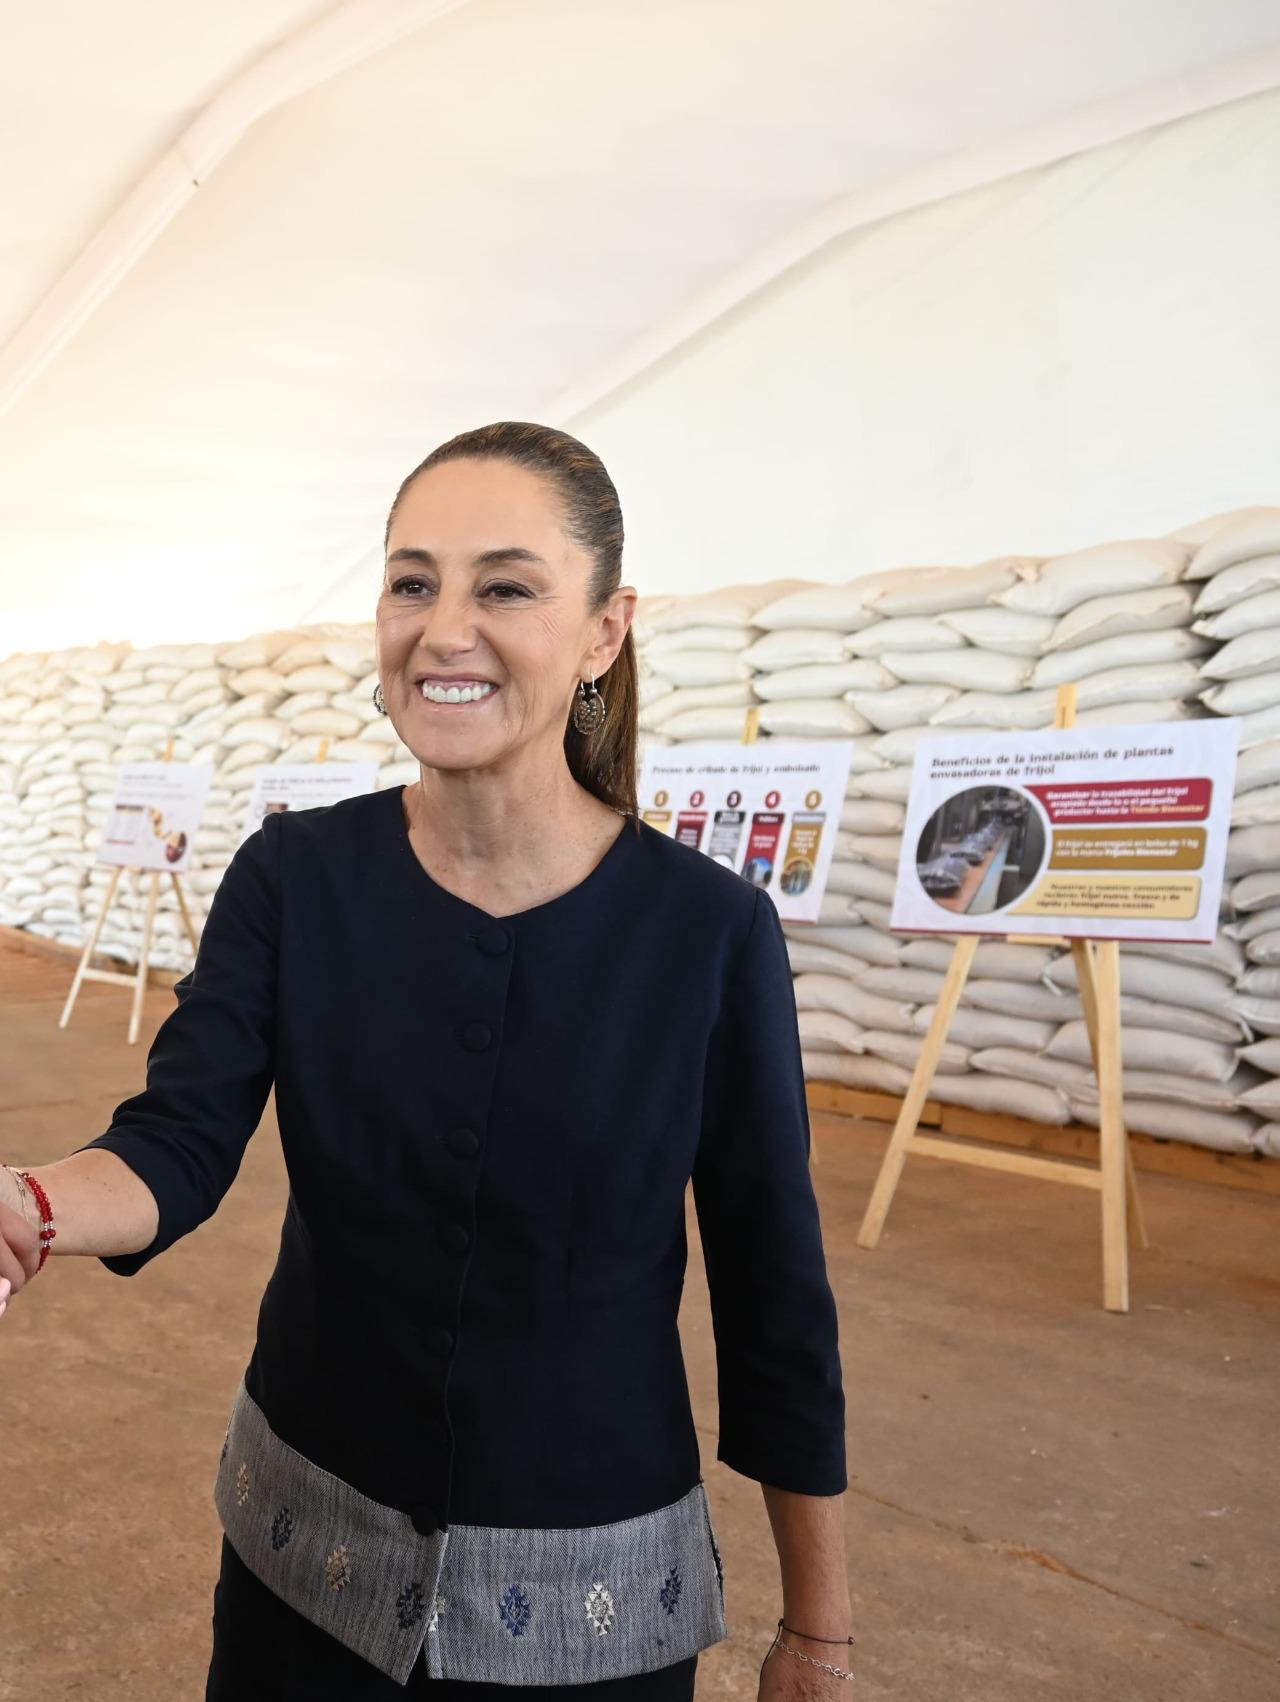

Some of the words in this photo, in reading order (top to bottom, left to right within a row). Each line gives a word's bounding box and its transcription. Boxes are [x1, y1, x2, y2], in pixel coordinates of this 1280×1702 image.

[931, 755, 992, 767] Beneficios
[996, 754, 1009, 765] de
[1015, 753, 1025, 764] la
[1029, 749, 1099, 763] instalación
[1103, 748, 1119, 759] de
[1123, 746, 1174, 760] plantas
[930, 768, 1002, 779] envasadoras
[1006, 766, 1019, 777] de
[1025, 764, 1055, 777] frijol
